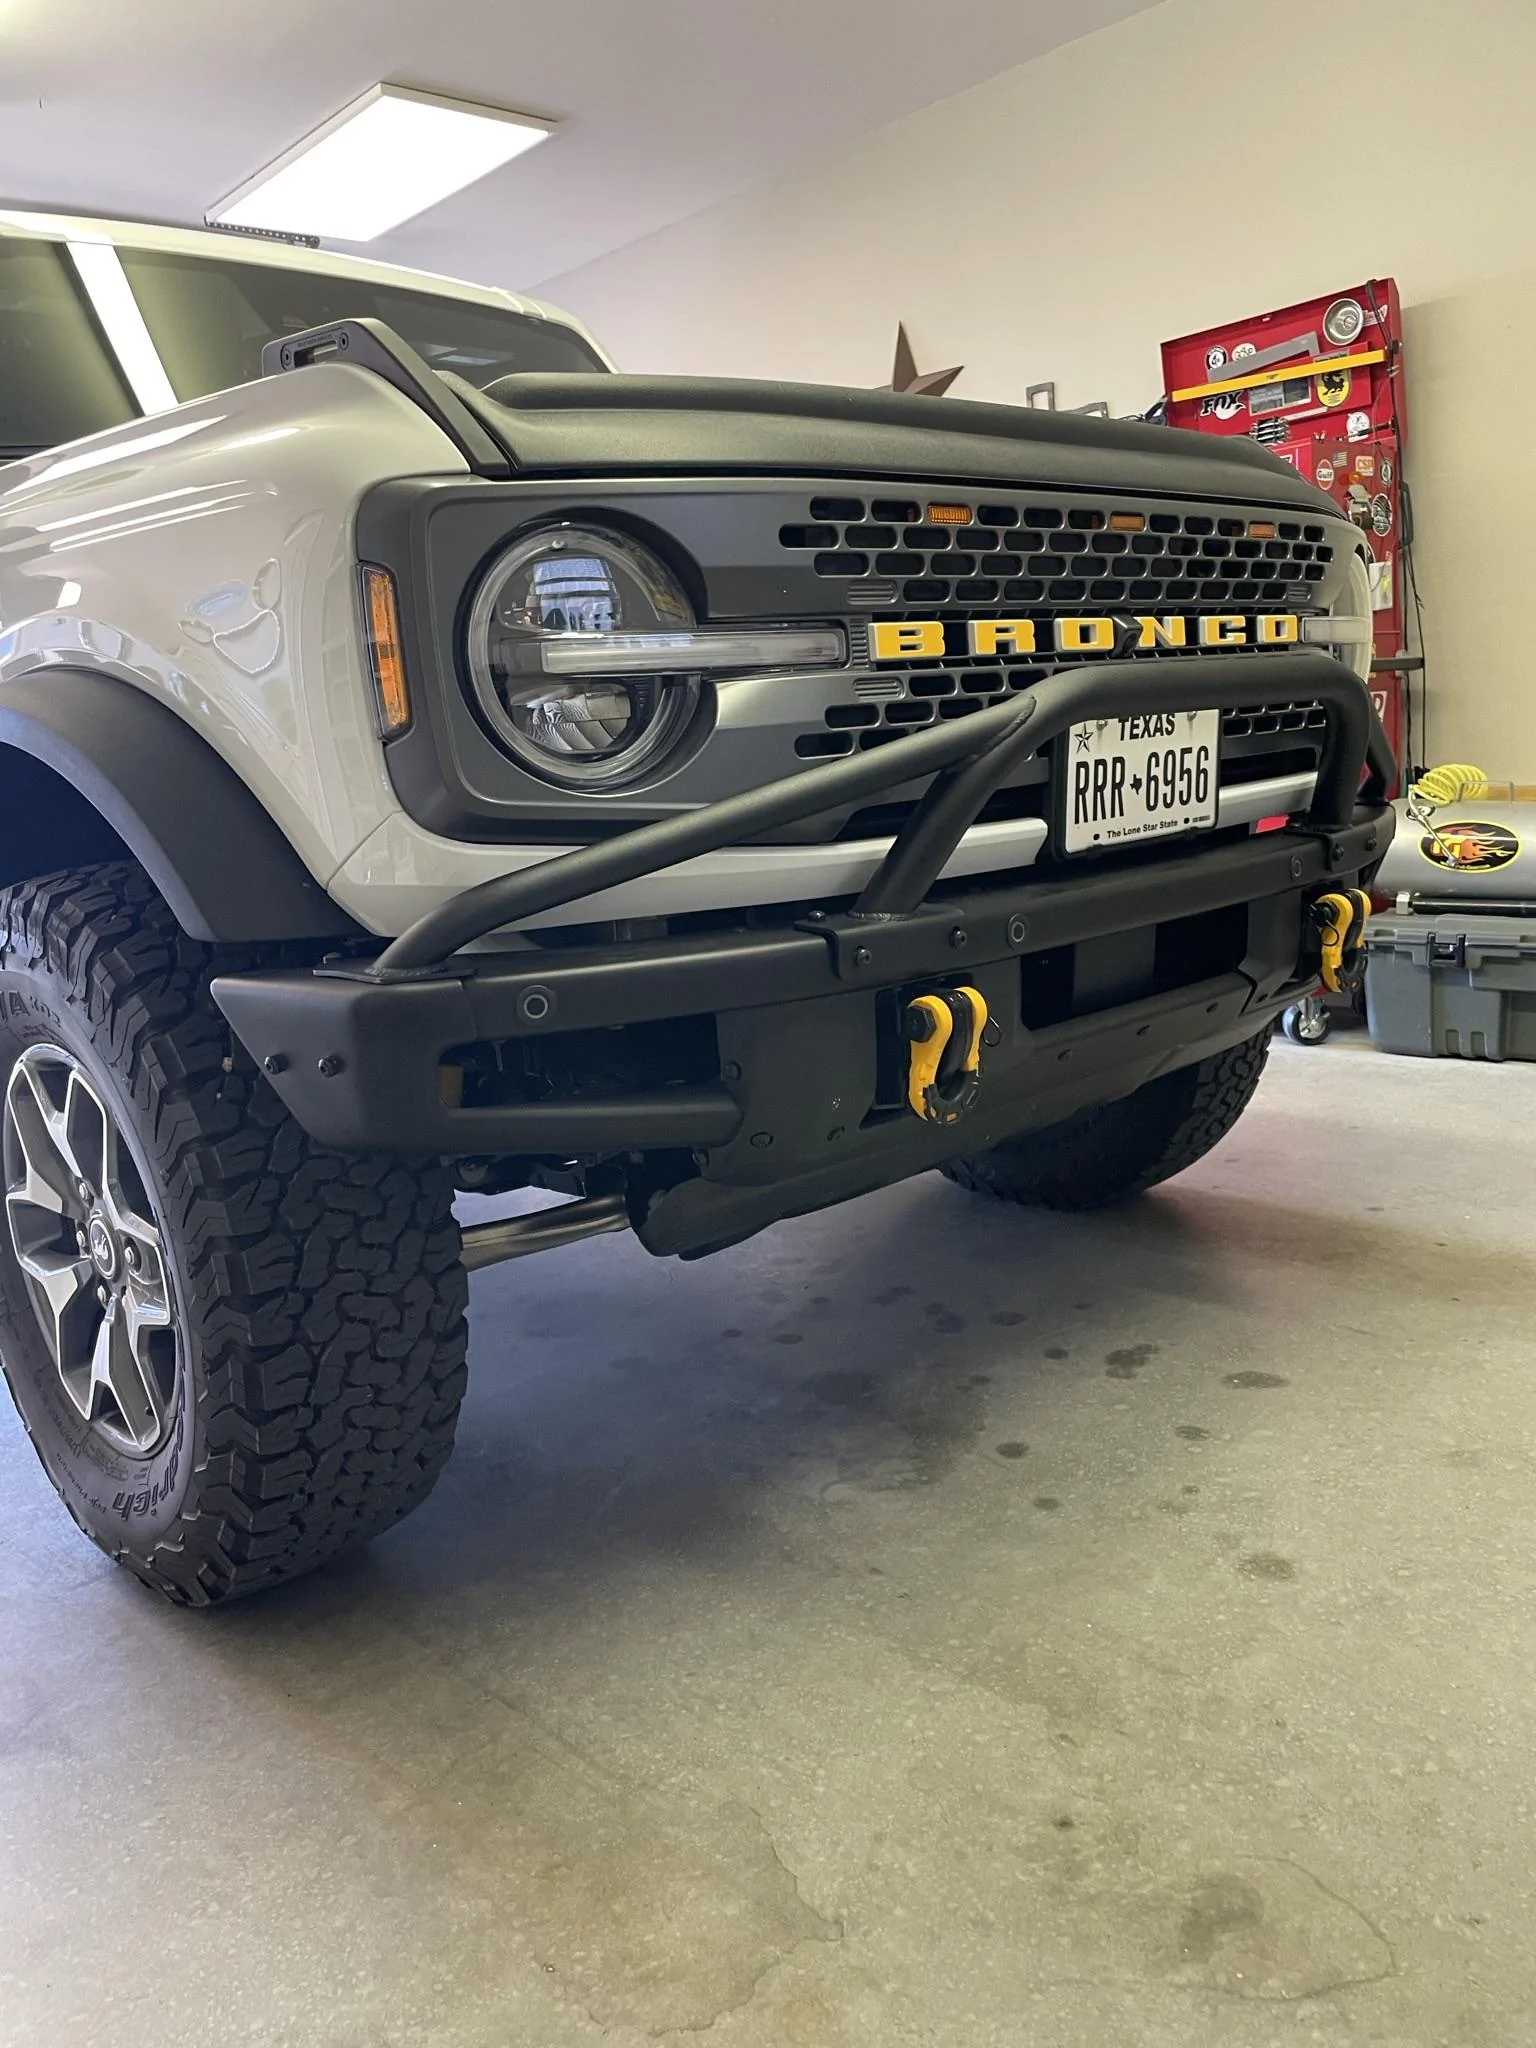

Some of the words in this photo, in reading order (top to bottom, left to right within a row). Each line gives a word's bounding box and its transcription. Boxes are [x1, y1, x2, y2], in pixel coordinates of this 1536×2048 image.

[1201, 391, 1241, 414] FOX
[1317, 470, 1333, 479] Gulf
[869, 615, 1298, 660] BRONCO
[1118, 714, 1176, 741] TEXAS
[1074, 756, 1126, 825] RRR
[1145, 745, 1209, 812] 6956
[1107, 829, 1121, 839] The
[1123, 825, 1141, 837] Lone
[1143, 821, 1158, 833] Star
[1160, 819, 1178, 830] State
